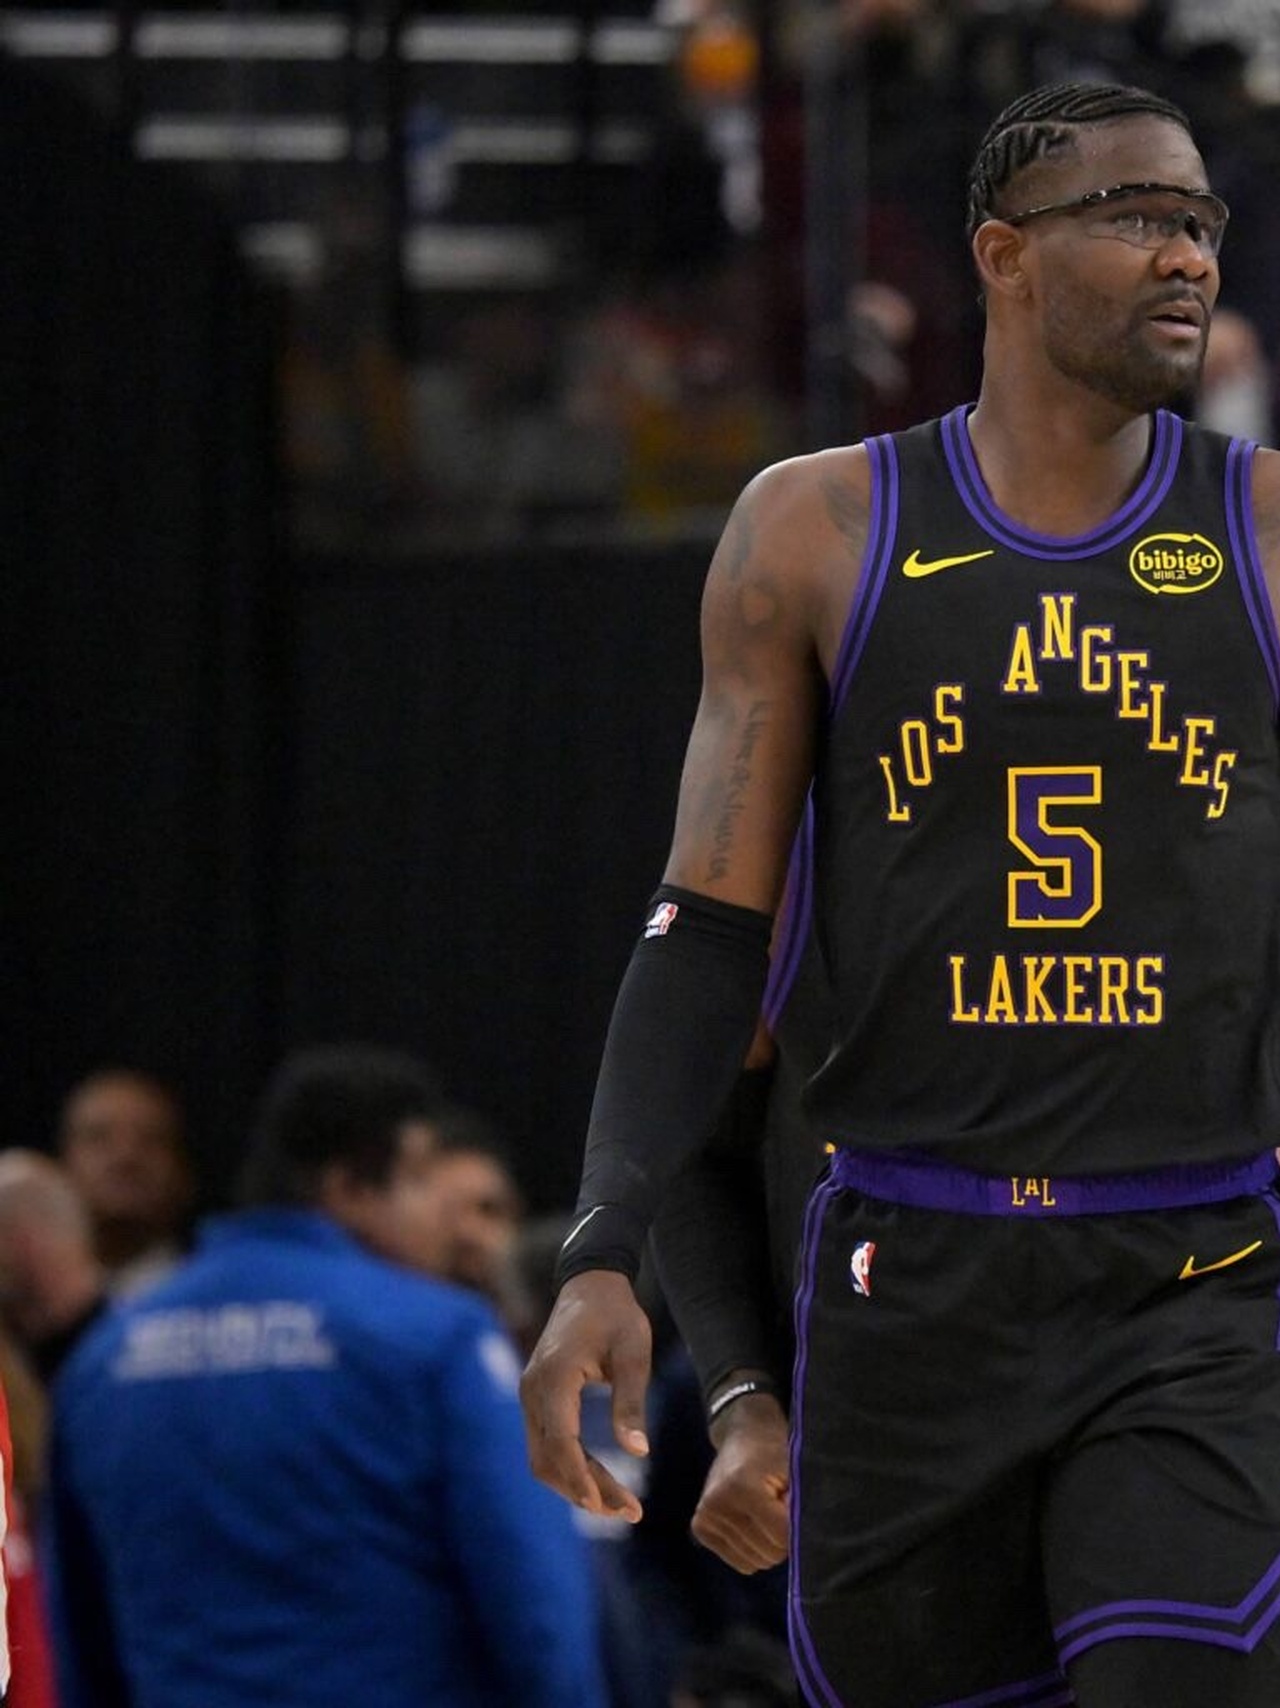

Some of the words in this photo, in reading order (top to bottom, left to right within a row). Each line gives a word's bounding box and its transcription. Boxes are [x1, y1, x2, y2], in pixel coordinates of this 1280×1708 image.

[1137, 549, 1217, 576] bibigo
[1152, 569, 1188, 580] 비비고
[877, 684, 965, 823] LOS
[1002, 594, 1238, 820] ANGELES
[1006, 764, 1104, 930] 5
[948, 953, 1164, 1026] LAKERS
[1011, 1178, 1057, 1206] LAL
